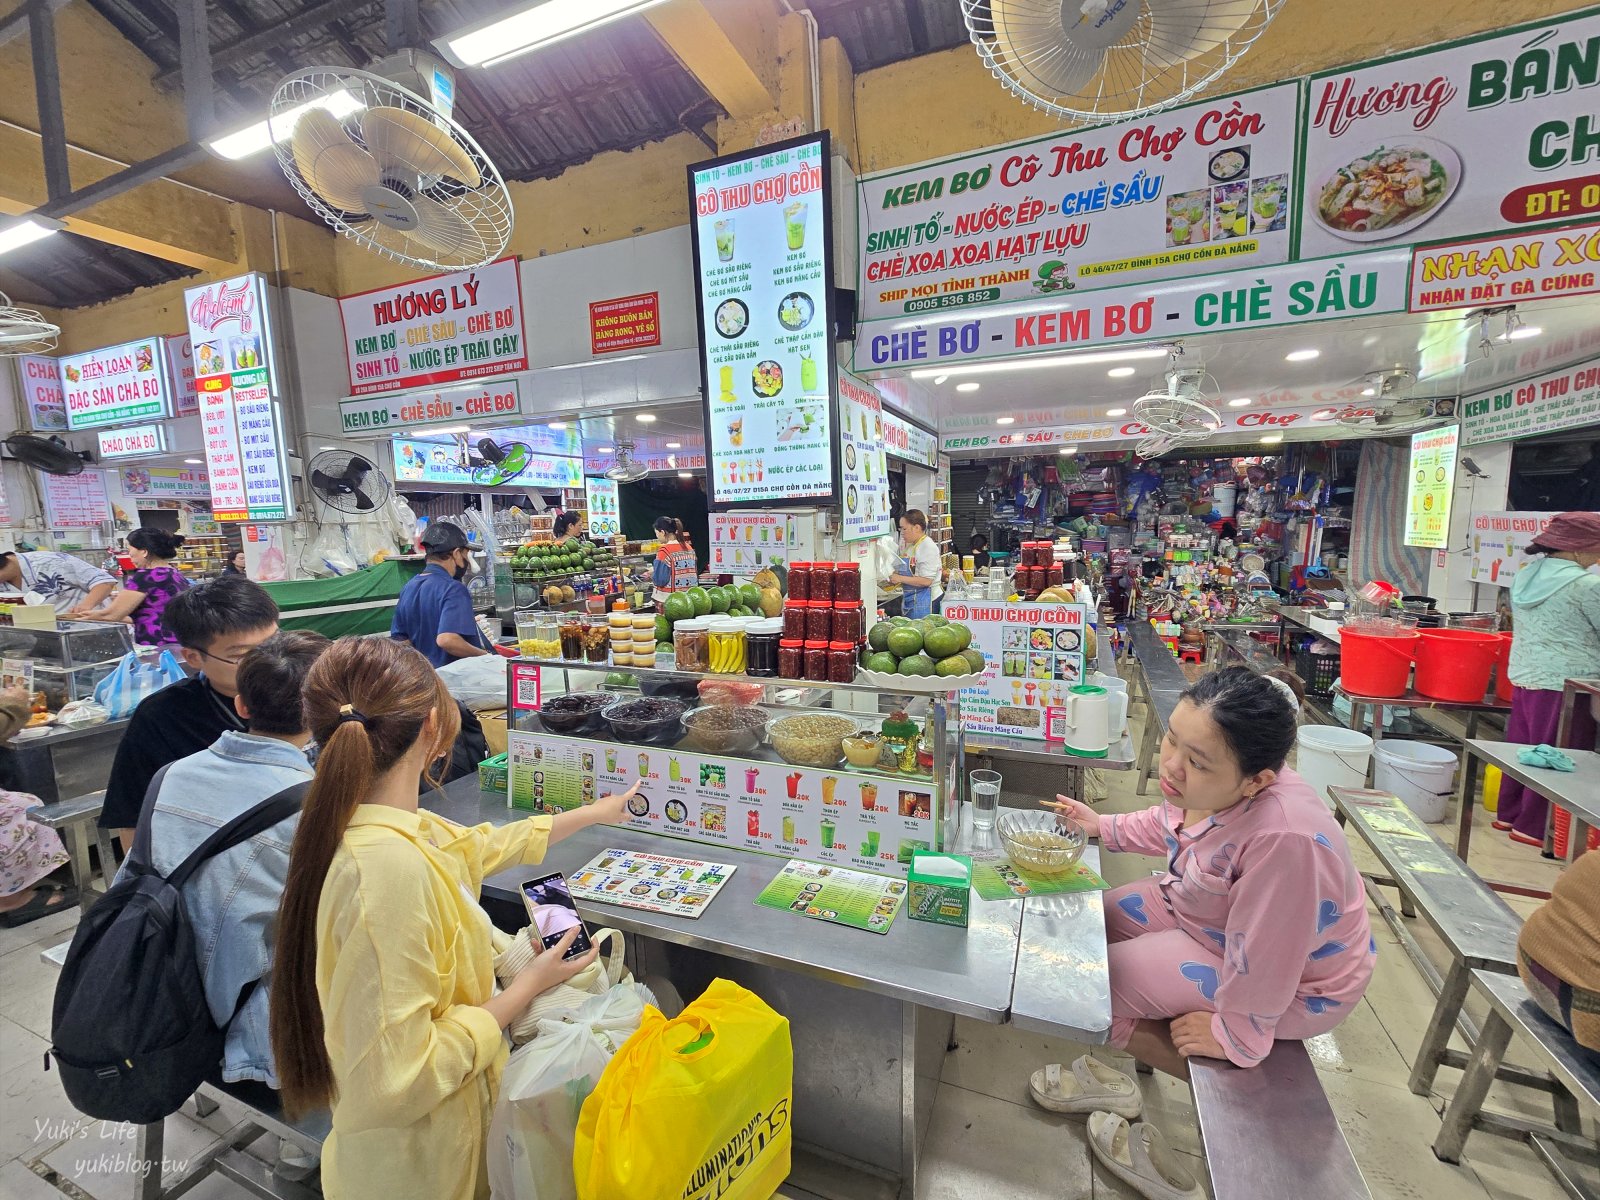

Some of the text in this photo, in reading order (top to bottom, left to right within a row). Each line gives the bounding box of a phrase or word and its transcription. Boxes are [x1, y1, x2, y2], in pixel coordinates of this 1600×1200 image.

[1312, 77, 1457, 138] Hương
[882, 101, 1265, 209] KEM BƠ Cô Thu Chợ Cồn
[696, 172, 710, 184] SINH
[727, 164, 742, 177] KEM
[696, 162, 822, 216] CÔ THU CHỢ CỒN
[867, 170, 1163, 253] SINH TỐ NƯỚC ÉP CHÈ SẦU
[1525, 191, 1572, 217] ĐT:
[867, 224, 1090, 281] CHÈ XOA XOA HẠT LỰU
[1081, 268, 1091, 276] LÔ
[1093, 262, 1128, 274] 46/47/27
[1131, 258, 1152, 268] ĐÌNH
[1155, 256, 1170, 264] 15A
[1173, 252, 1191, 262] CHỢ
[1215, 246, 1226, 255] ĐÀ
[373, 273, 480, 326] HƯƠNG LÝ
[879, 267, 1030, 302] SHIP MỌI TỈNH THÀNH
[908, 289, 990, 311] 0905 536 852
[1420, 273, 1594, 305] NHẬN ĐẶT GÀ CÚNG
[190, 276, 254, 333] Welcome
[871, 264, 1379, 363] CHÈ BƠ KEM BƠ CHÈ SẦU
[241, 315, 252, 334] to
[355, 306, 515, 356] KEM BƠ CHÈ SẦU CHÈ BƠ
[82, 355, 132, 379] HIỀN LOAN
[356, 334, 519, 380] SINH TỐ NƯỚC ÉP TRÁI CÂY
[69, 374, 159, 412] ĐẶC SẢN CHẢ BÒ
[235, 388, 268, 402] BESTSELLER
[343, 391, 516, 428] KEM BƠ CHÈ SẦU CHÈ BƠ
[1465, 376, 1570, 418] KEM BƠ CÔ THU
[126, 431, 143, 451] CHẢ
[884, 421, 896, 448] CHỢ
[897, 426, 908, 451] CỒN
[944, 412, 1302, 448] KEM Chợ
[794, 463, 808, 473] CÁC
[1476, 516, 1489, 530] CÔ
[1492, 517, 1510, 531] THU
[1512, 518, 1537, 535] CHỢ
[946, 605, 1081, 625] CÔ THU CHỢ CỒN
[914, 811, 929, 819] 20K
[880, 852, 894, 860] 25K
